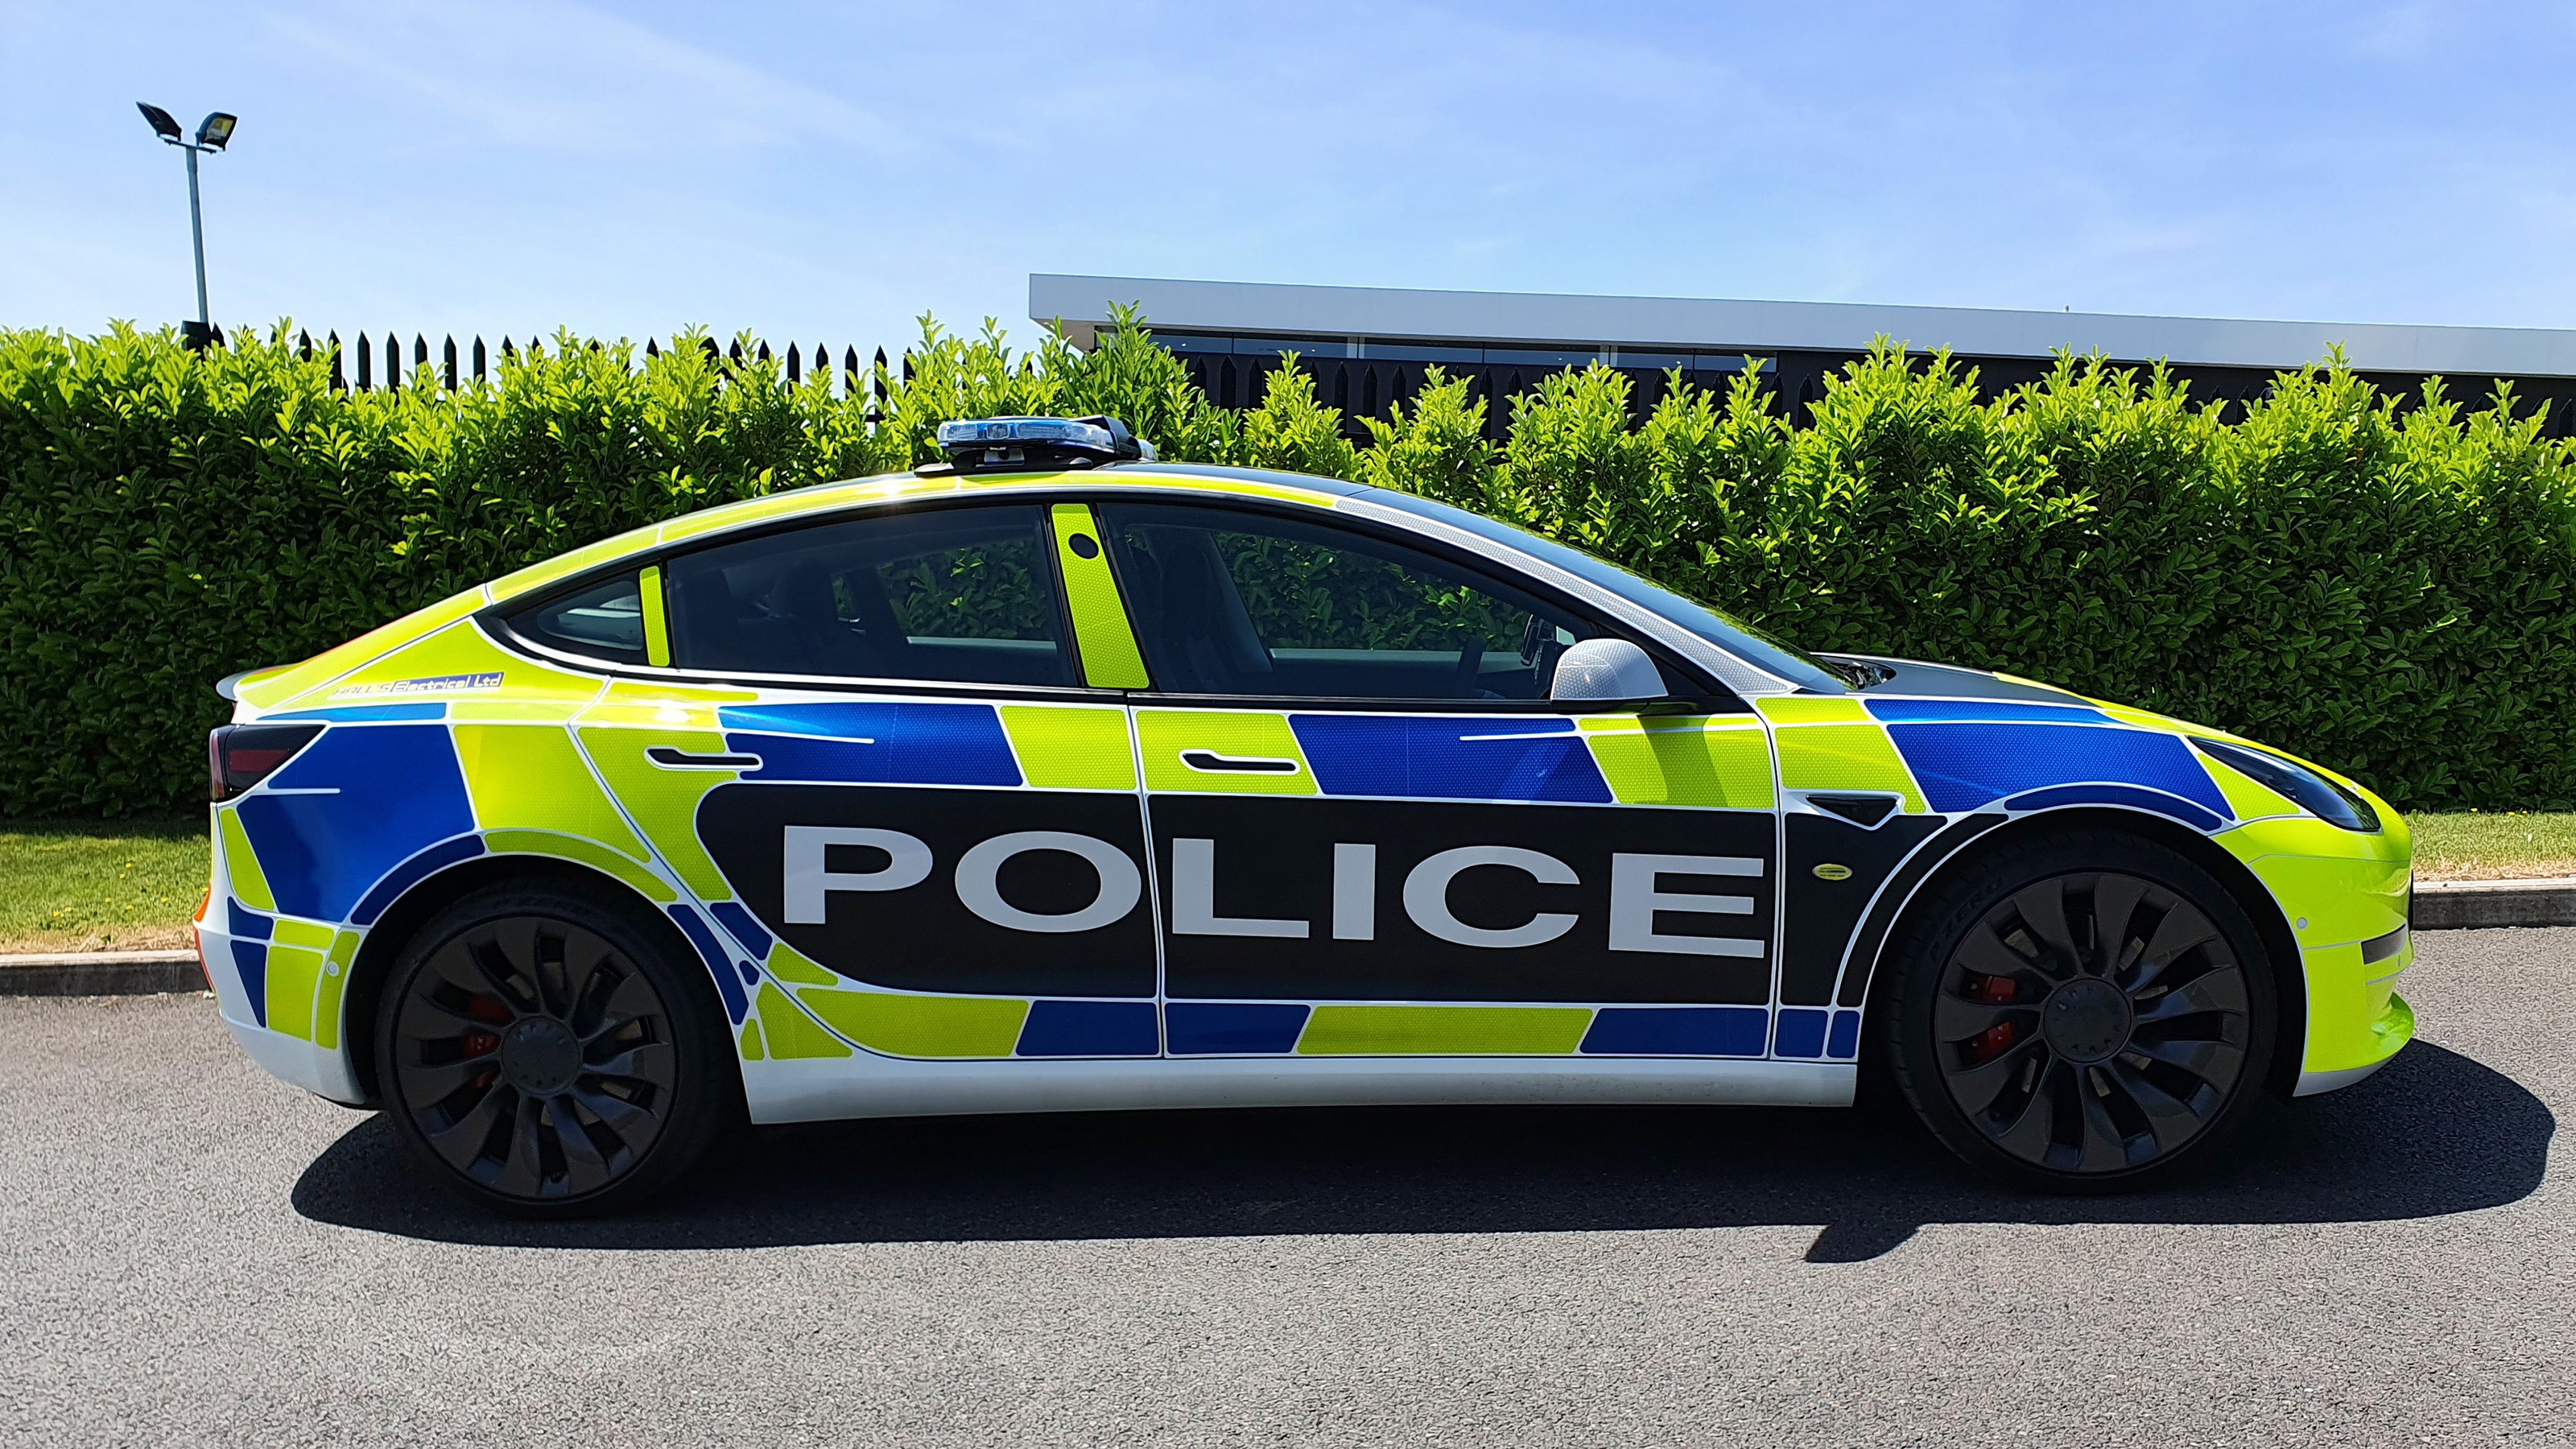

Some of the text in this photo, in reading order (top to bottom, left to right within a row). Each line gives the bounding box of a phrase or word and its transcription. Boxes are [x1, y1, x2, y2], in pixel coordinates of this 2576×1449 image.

[393, 675, 471, 693] Electrical
[473, 673, 502, 687] Ltd
[783, 825, 1765, 959] POLICE
